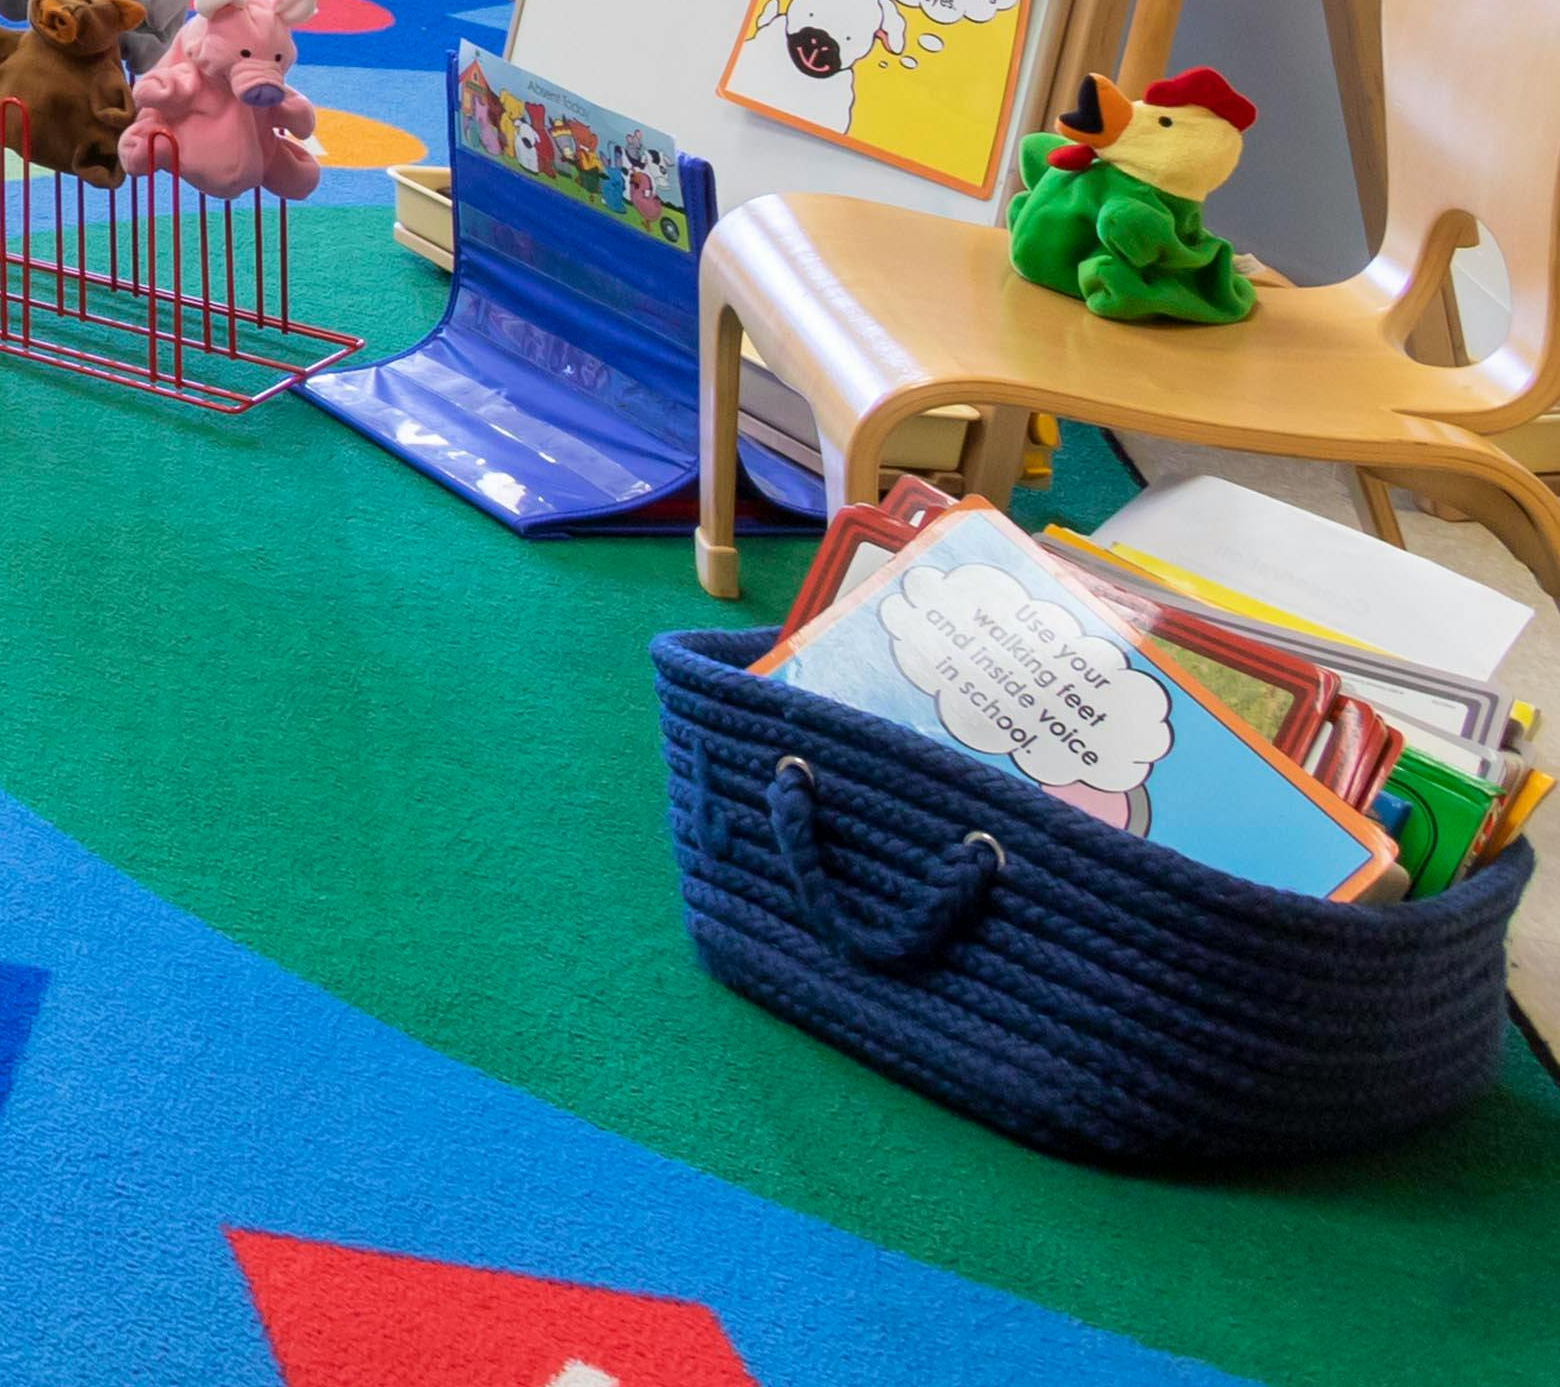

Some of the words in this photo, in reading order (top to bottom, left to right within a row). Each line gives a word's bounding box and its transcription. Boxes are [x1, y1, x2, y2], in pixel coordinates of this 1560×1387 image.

[528, 81, 561, 104] Absent
[925, 609, 976, 649] and
[969, 647, 1035, 708] inside
[1039, 708, 1099, 766] voice
[972, 608, 1058, 688] walking
[1056, 683, 1107, 727] feet
[1015, 604, 1056, 644] Use
[1053, 644, 1111, 689] your
[935, 656, 960, 681] in
[959, 681, 1038, 754] school.
